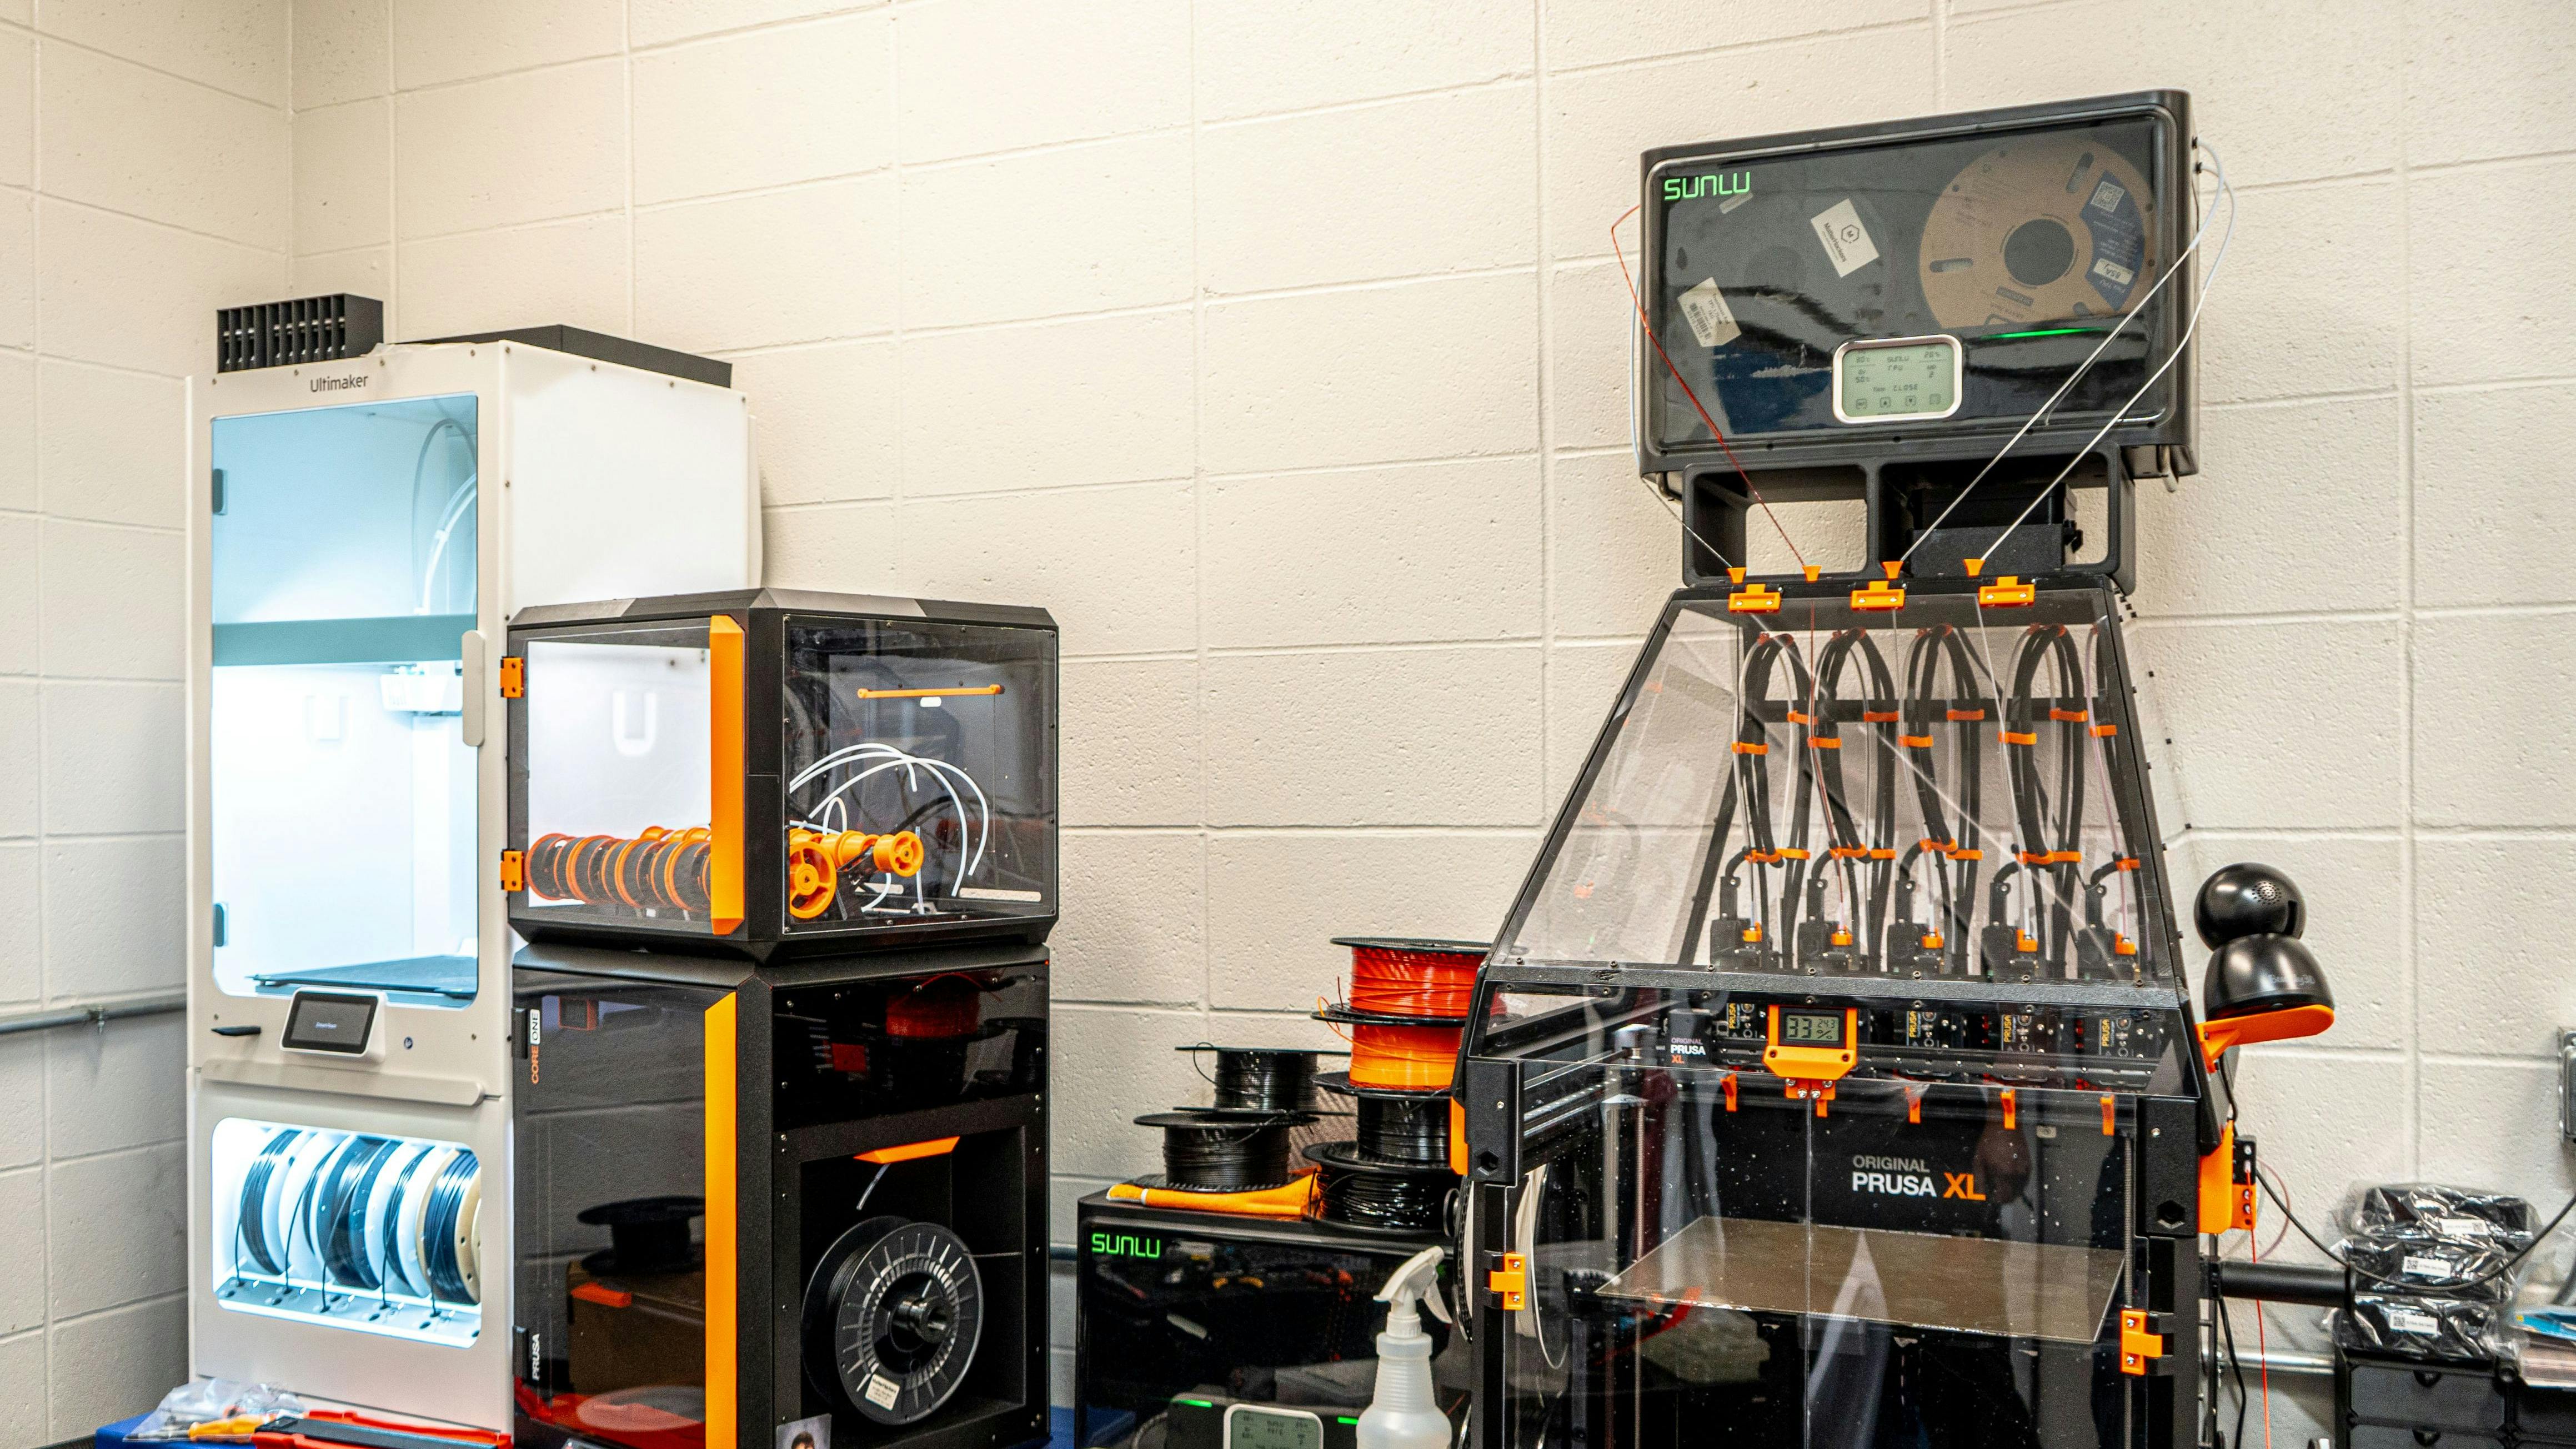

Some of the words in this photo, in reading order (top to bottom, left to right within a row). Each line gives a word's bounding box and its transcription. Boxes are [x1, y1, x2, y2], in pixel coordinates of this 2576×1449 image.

[1664, 171, 1750, 200] SUNLU
[310, 374, 368, 392] Ultimaker
[1728, 1003, 1737, 1029] PRUSA
[1789, 1017, 1812, 1038] 33
[1909, 1011, 1917, 1038] PRUSA
[1671, 1037, 1703, 1045] ORIGINAL
[2102, 1019, 2110, 1047] PRUSA
[1670, 1044, 1706, 1055] PRUSA
[1671, 1055, 1685, 1064] XL
[1852, 1155, 1931, 1174] ORIGINAL
[1852, 1171, 1937, 1198] PRUSA
[1943, 1172, 1987, 1201] XL
[1091, 1233, 1160, 1259] SUNLU
[532, 1333, 540, 1381] PRUSA
